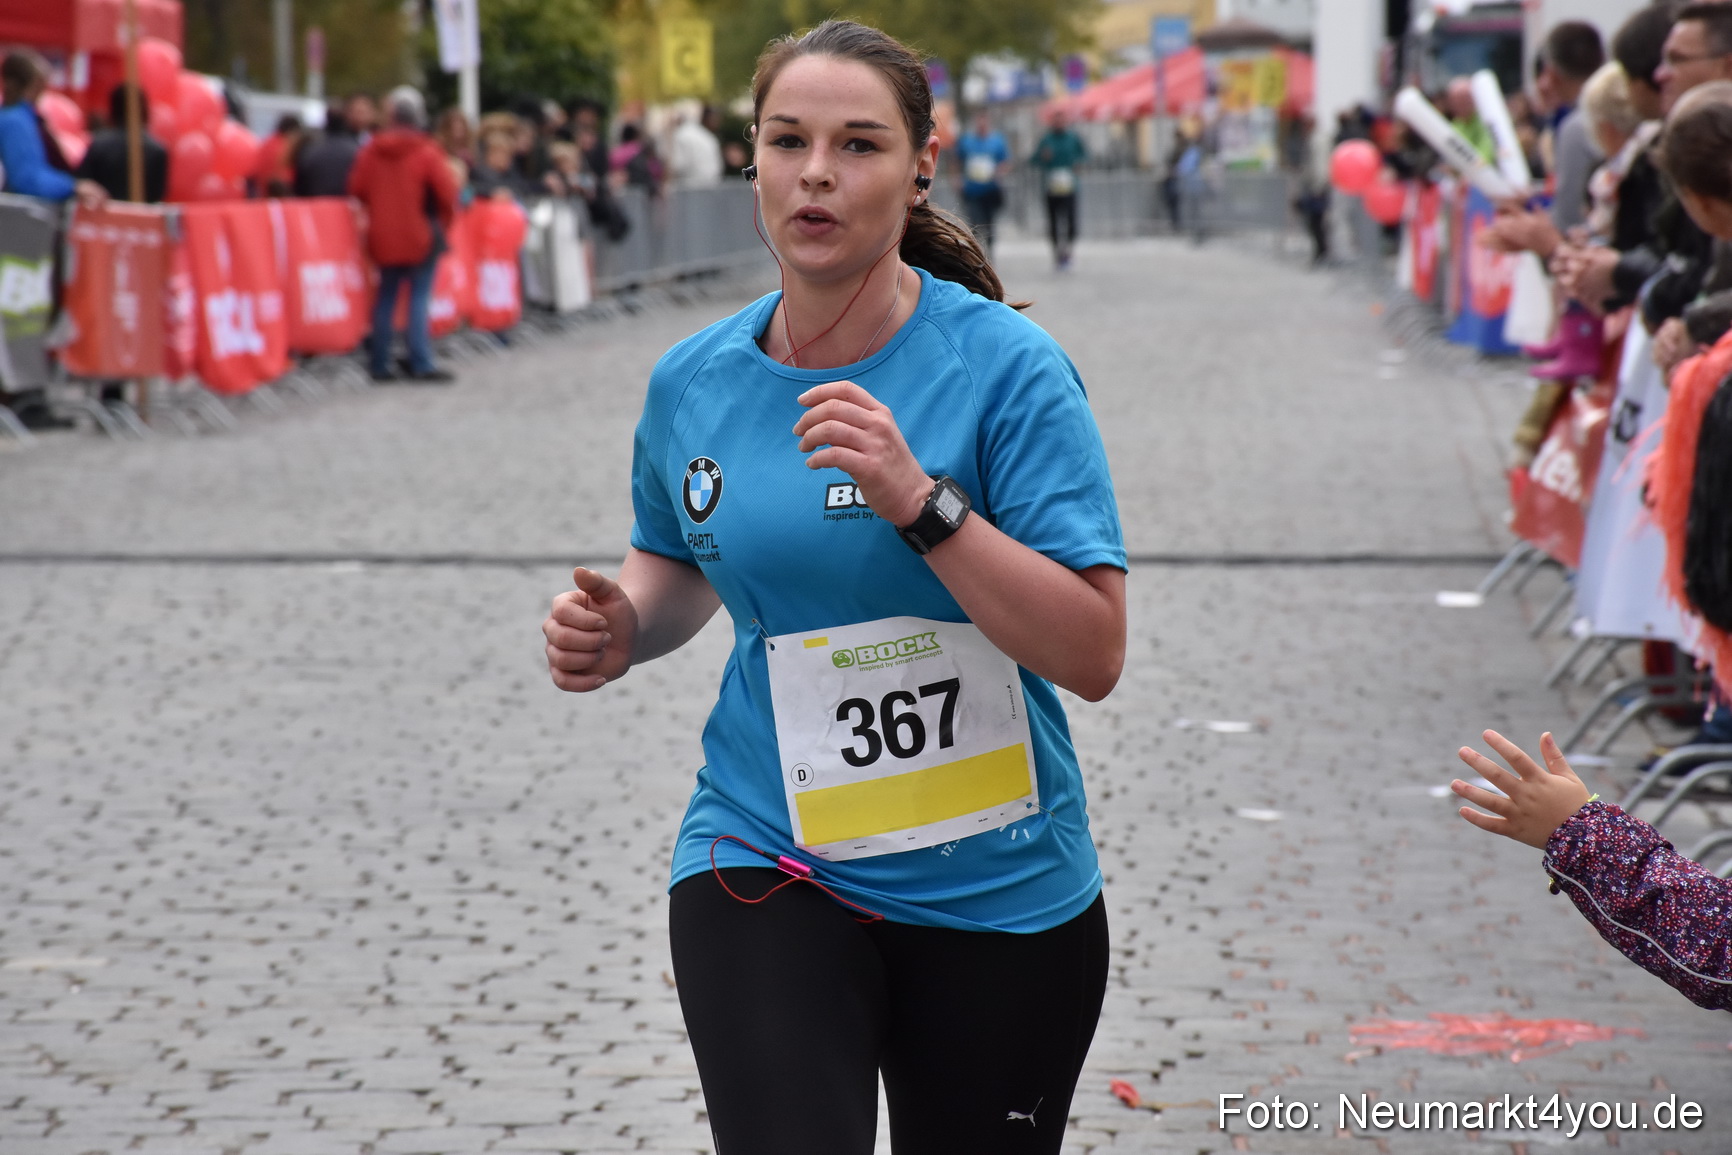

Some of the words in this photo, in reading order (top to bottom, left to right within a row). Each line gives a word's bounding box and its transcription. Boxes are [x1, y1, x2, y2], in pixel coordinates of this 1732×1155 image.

[686, 459, 721, 480] BMW
[823, 510, 860, 522] inspired
[862, 510, 874, 520] by
[687, 532, 719, 549] PARTL
[855, 632, 941, 665] BOCK
[859, 661, 884, 672] inspired
[895, 656, 914, 666] smart
[914, 649, 943, 661] concepts
[836, 677, 961, 767] 367
[797, 769, 807, 782] D
